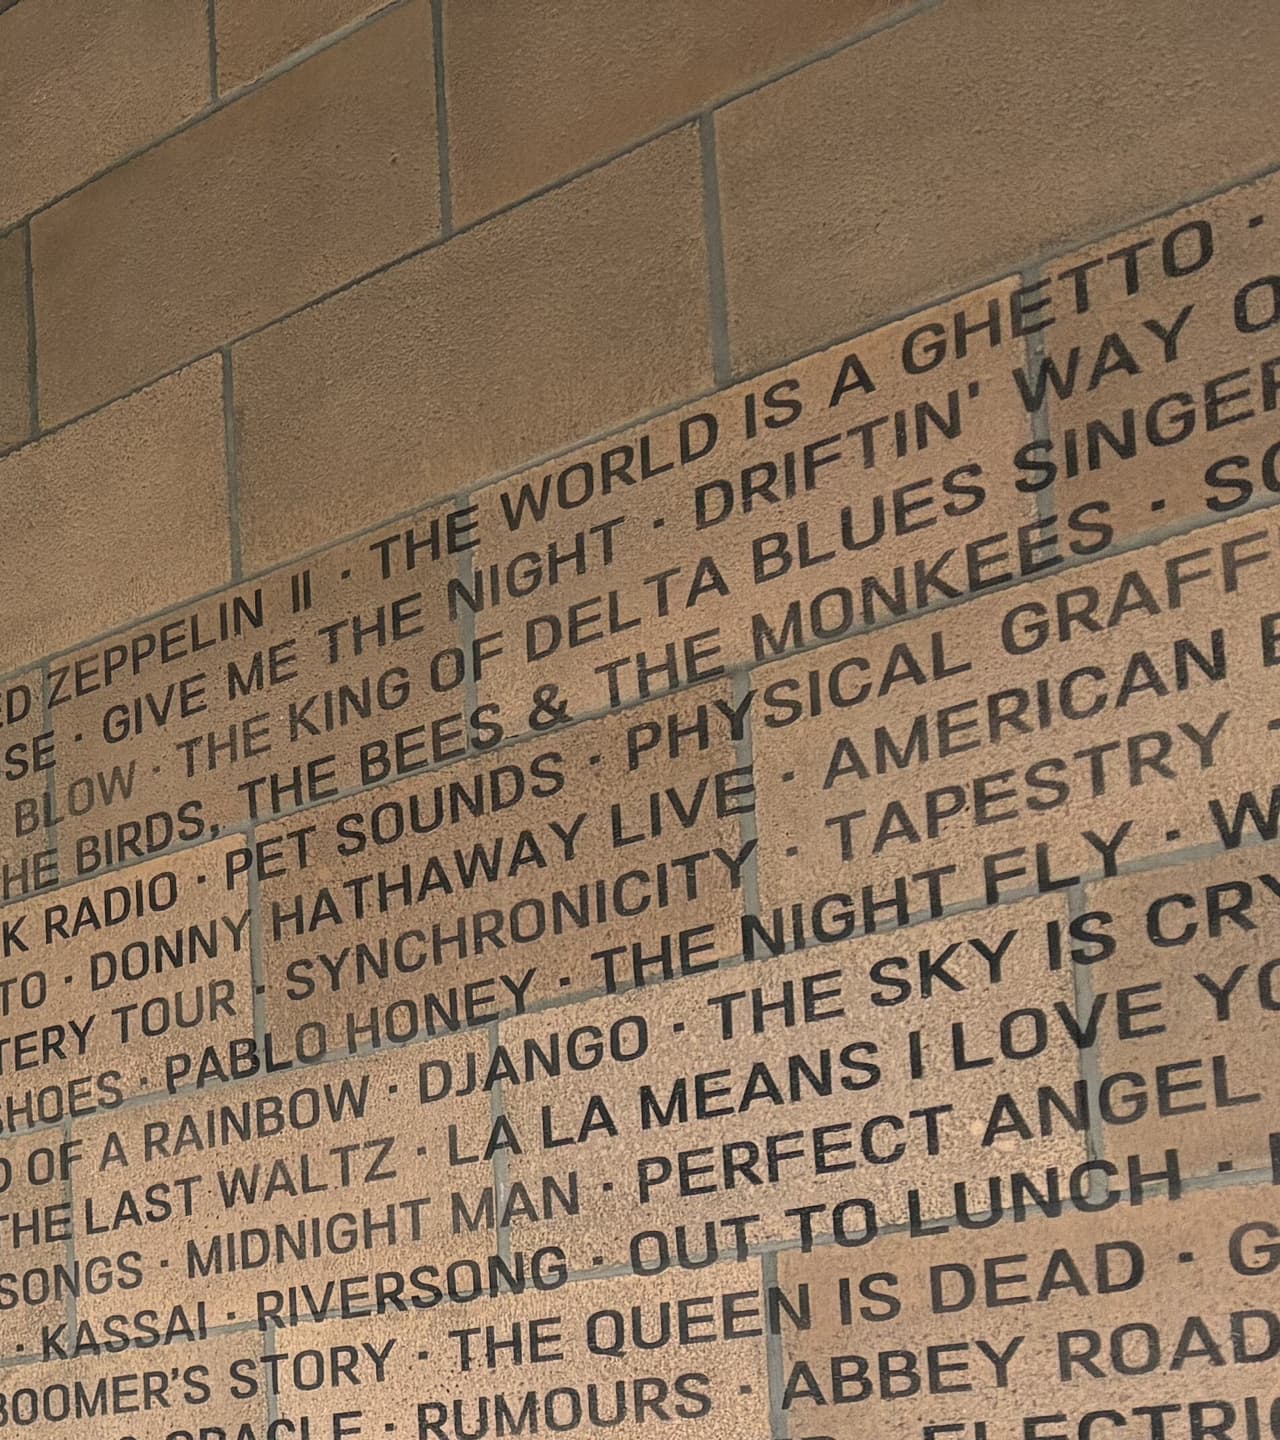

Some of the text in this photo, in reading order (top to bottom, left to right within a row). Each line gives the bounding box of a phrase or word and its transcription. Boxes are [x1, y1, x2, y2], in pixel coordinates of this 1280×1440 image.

[46, 588, 263, 708] ZEPPELIN
[290, 568, 311, 614] II
[369, 502, 481, 586] THE
[499, 407, 719, 534] WORLD
[743, 374, 803, 440] IS
[826, 347, 875, 408] A
[900, 213, 1214, 383] GHETTO
[75, 792, 219, 880] BIRDS,
[237, 753, 338, 825] THE
[359, 699, 503, 787] BEES
[526, 676, 573, 735] &
[594, 626, 725, 714] THE
[751, 495, 1114, 662] MONKEES
[111, 977, 235, 1046] TOUR
[285, 838, 759, 1003] SYNCHRONICITY
[824, 712, 1230, 865] TAPESTRY
[84, 1175, 203, 1235] LAST
[216, 1136, 396, 1210] WALTZ
[447, 1111, 522, 1167] LA
[541, 1092, 618, 1149] LA
[638, 1038, 882, 1132] MEANS
[908, 1028, 924, 1080] I
[950, 981, 1166, 1073] LOVE
[229, 1338, 397, 1401] STORY
[447, 1316, 564, 1373] THE
[585, 1283, 811, 1358] QUEEN
[837, 1269, 902, 1326] IS
[929, 1237, 1146, 1314] DEAD
